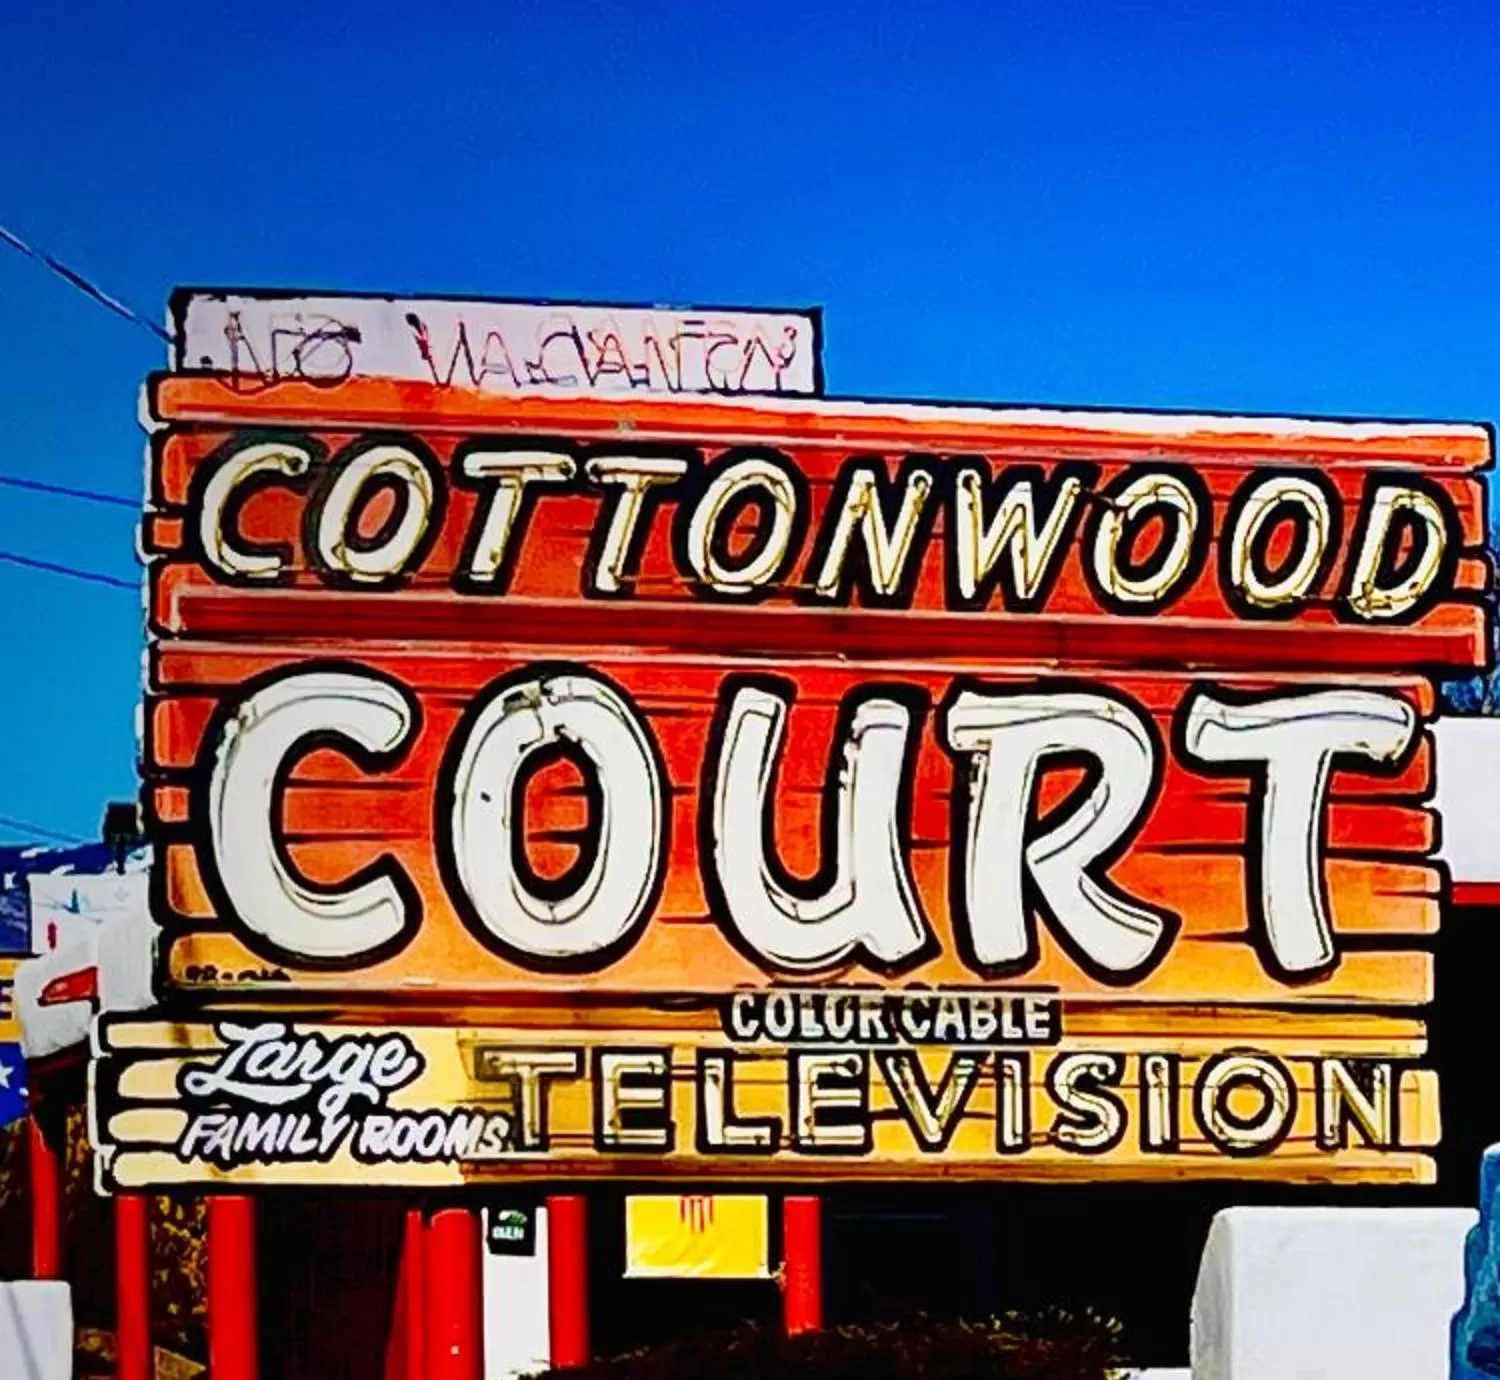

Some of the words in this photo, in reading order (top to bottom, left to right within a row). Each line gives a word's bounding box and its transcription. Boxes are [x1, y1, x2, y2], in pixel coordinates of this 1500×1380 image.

[198, 440, 1450, 620] COTTONWOOD
[208, 669, 1418, 976] COURT
[731, 991, 890, 1040] COLOR
[900, 994, 1051, 1040] CABLE
[183, 1021, 417, 1116] Large
[482, 1049, 1393, 1152] TELEVISION
[180, 1110, 350, 1160] FAMILY
[358, 1113, 510, 1157] ROOMS
